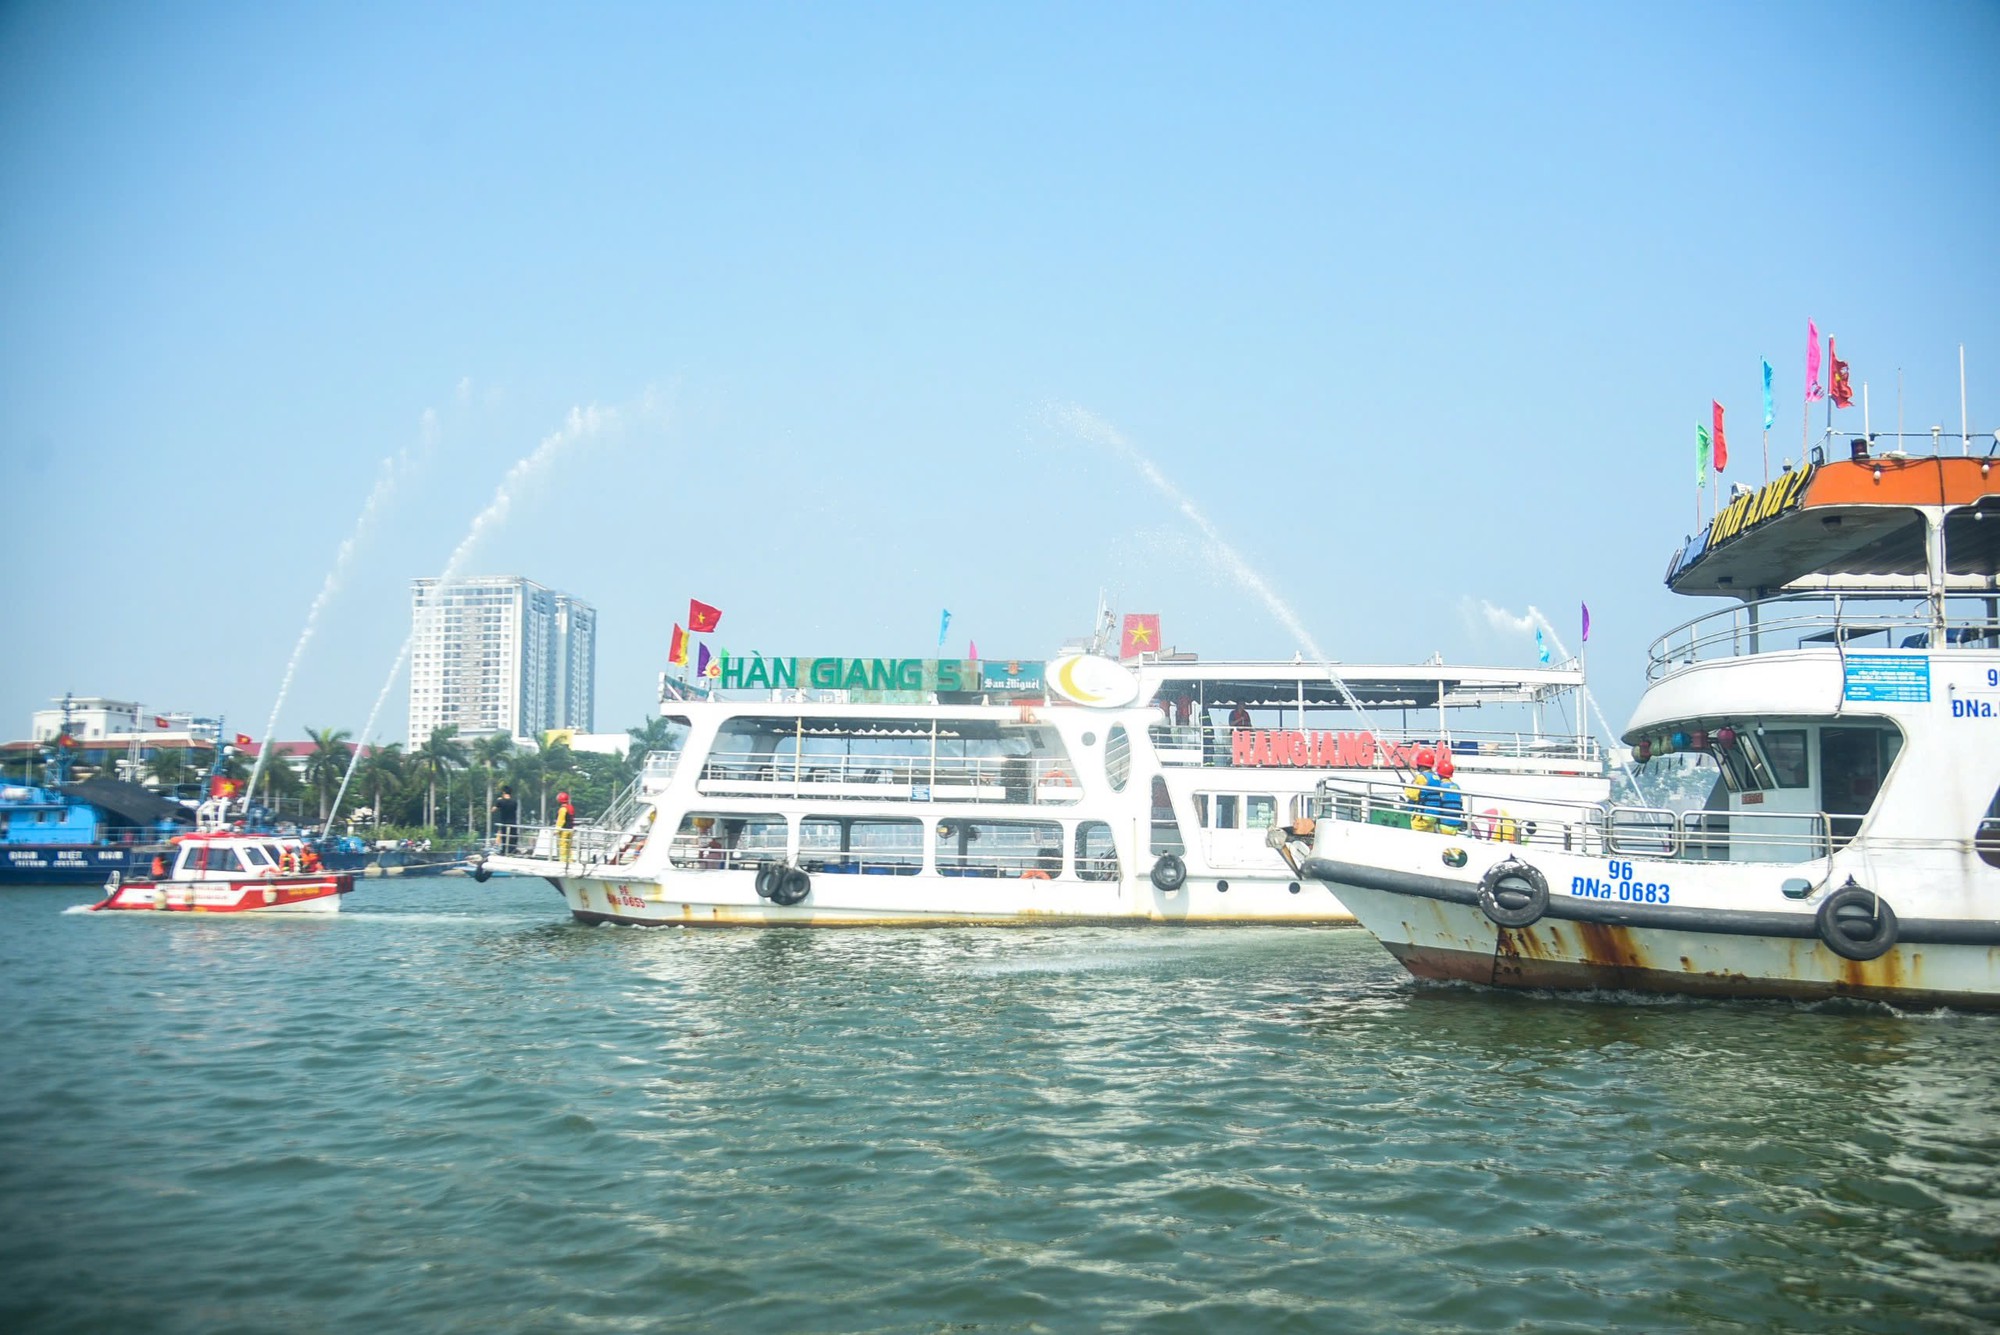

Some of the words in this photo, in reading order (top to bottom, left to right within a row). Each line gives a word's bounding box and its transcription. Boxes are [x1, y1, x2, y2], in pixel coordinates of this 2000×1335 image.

[1741, 471, 1796, 529] ANH
[1783, 463, 1812, 509] 2
[720, 650, 797, 689] HÀN
[809, 657, 923, 689] GIANG
[937, 659, 962, 691] 5
[1987, 668, 2000, 687] 9
[984, 678, 1004, 689] San
[1608, 860, 1633, 881] 96
